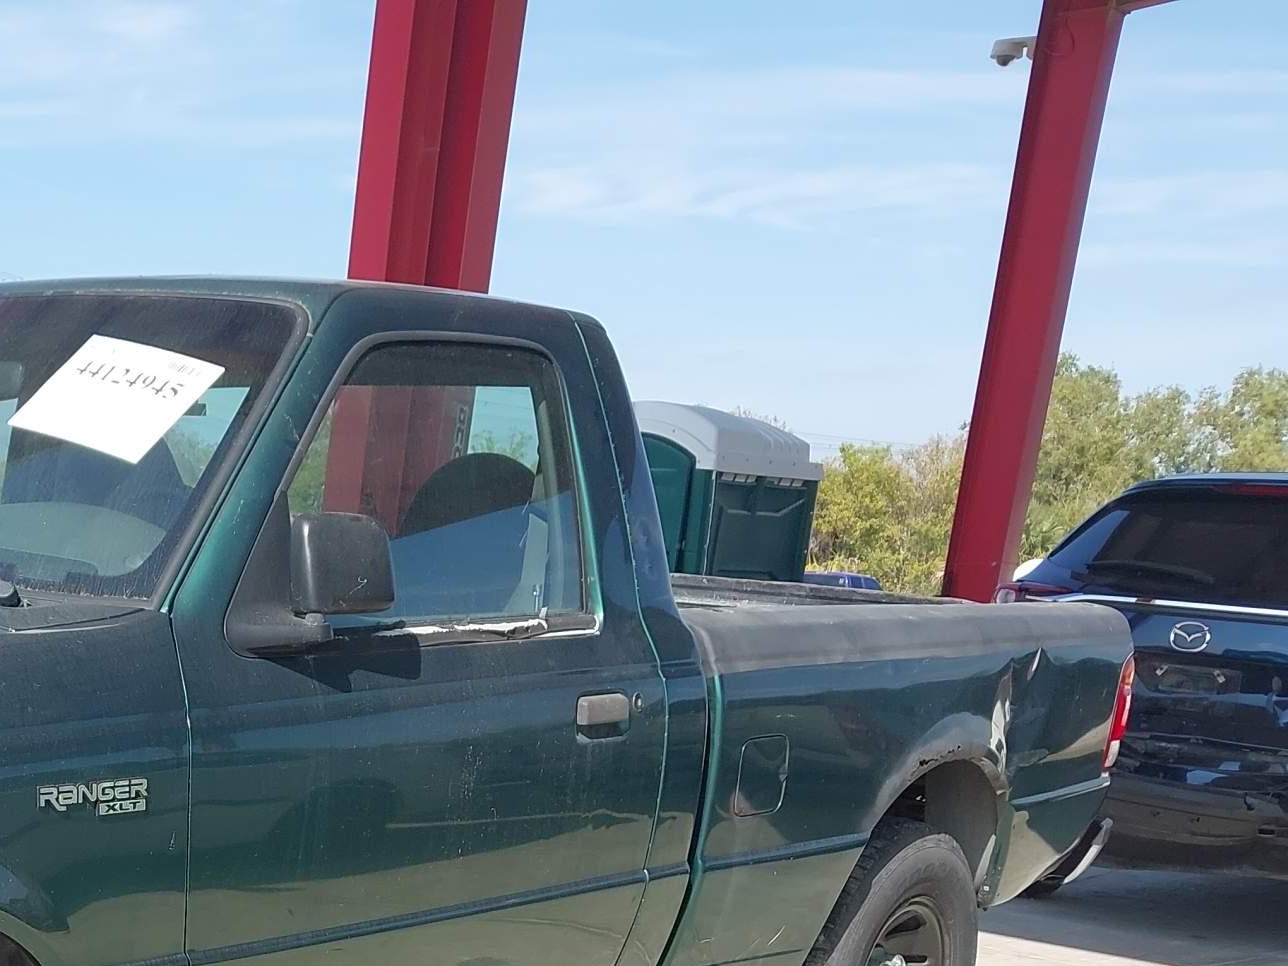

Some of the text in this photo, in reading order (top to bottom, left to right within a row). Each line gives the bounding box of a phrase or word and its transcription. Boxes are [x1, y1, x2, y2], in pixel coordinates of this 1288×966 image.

[76, 361, 184, 399] 44124945
[39, 778, 149, 812] RANGER
[102, 800, 142, 814] XLT
